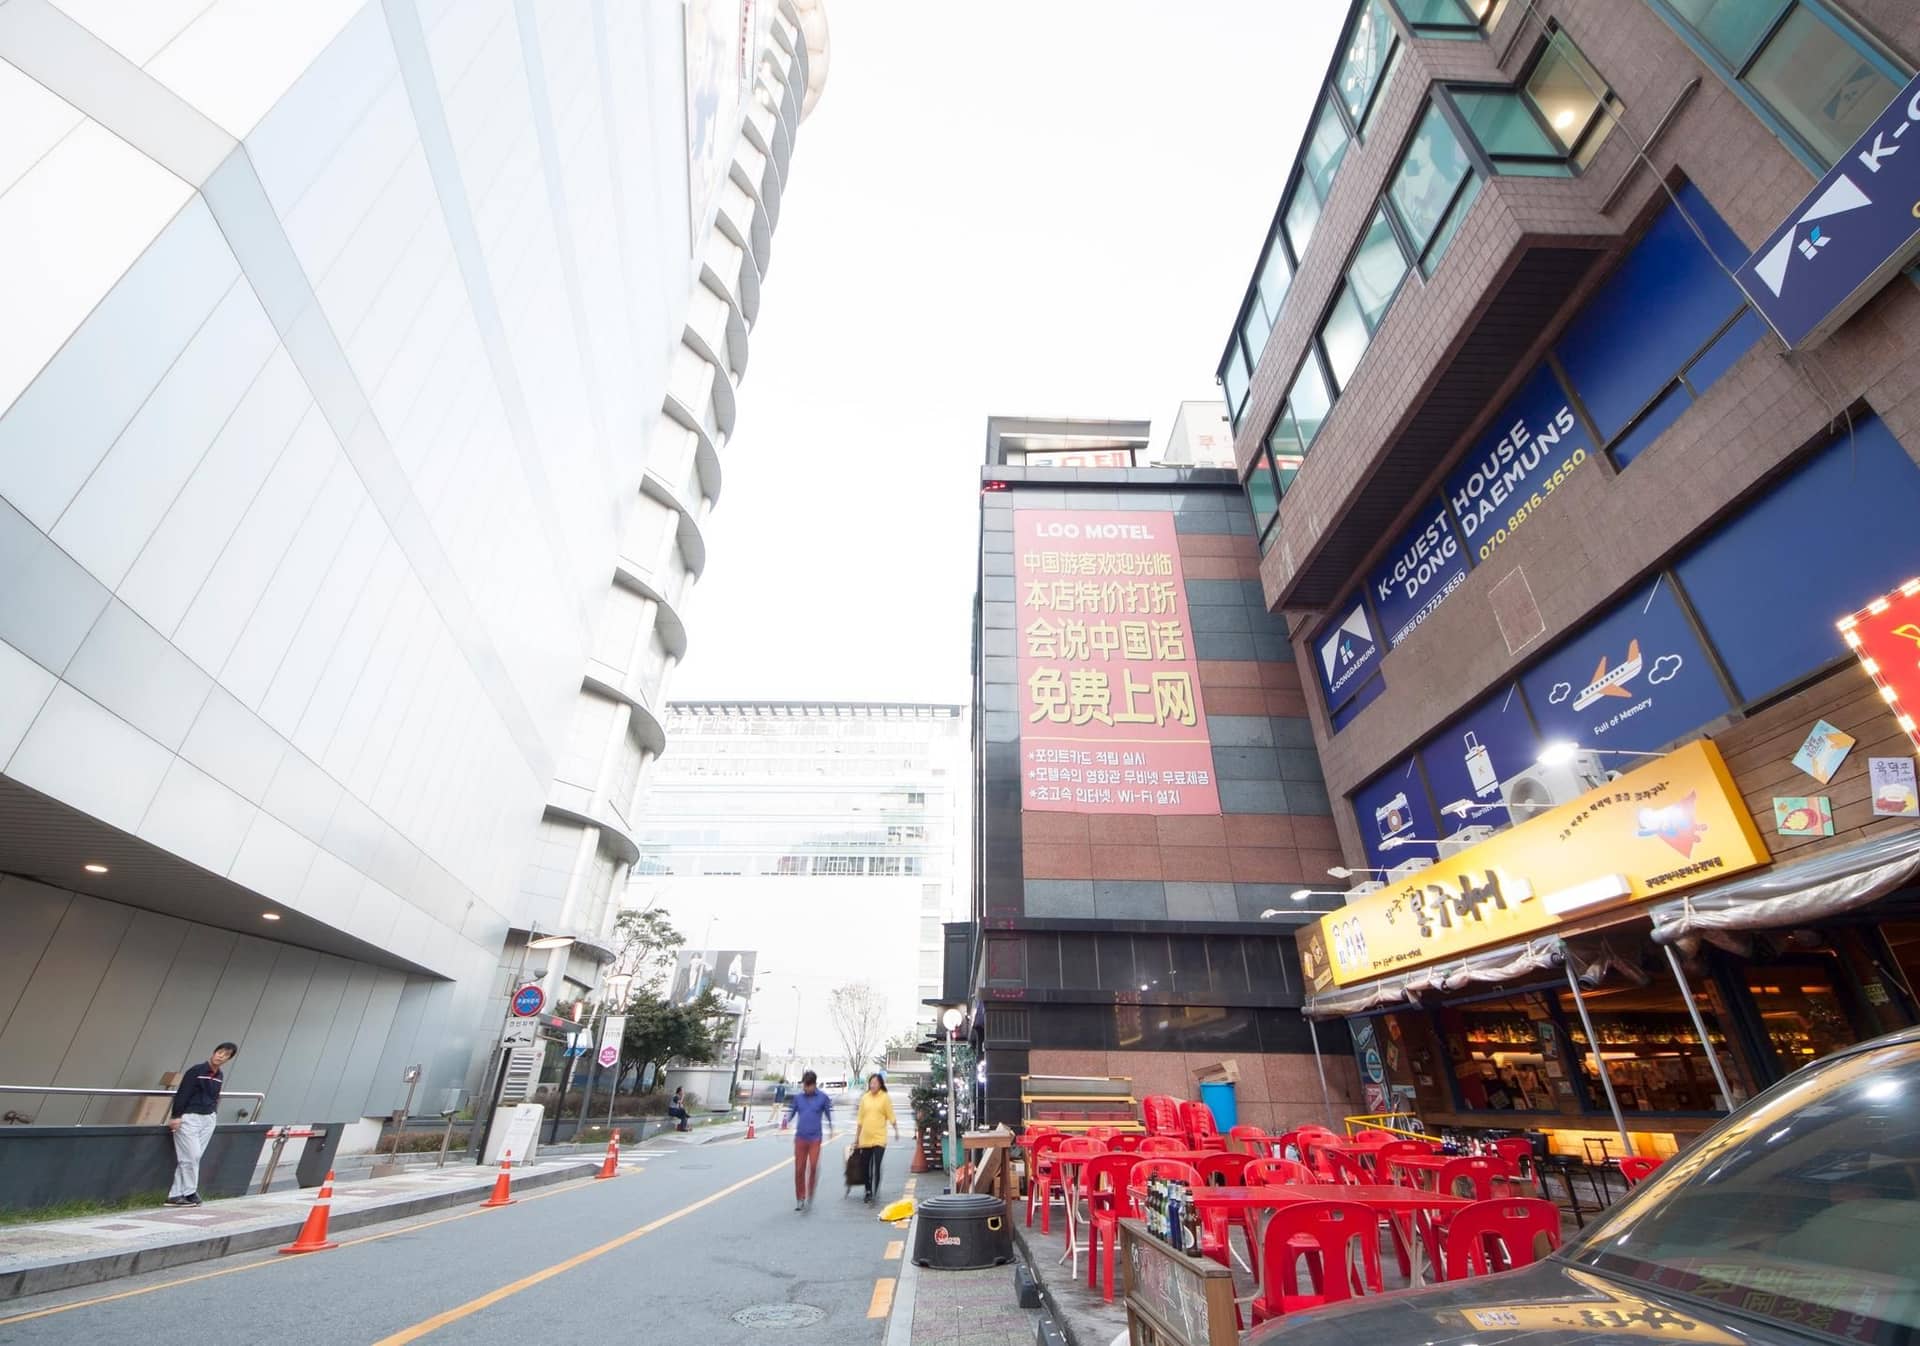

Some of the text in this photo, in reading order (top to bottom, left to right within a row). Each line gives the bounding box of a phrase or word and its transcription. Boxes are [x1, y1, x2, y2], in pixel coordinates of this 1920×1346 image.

[1378, 419, 1531, 602] K-GUEST HOUSE
[1404, 406, 1576, 600] DONG DAEMUN5
[1479, 448, 1587, 561] 070.8816.3650
[1036, 522, 1155, 540] LOO MOTEL
[1023, 551, 1173, 576] 中国游客欢迎光临
[1023, 579, 1178, 614] 本店特价打折
[1415, 572, 1466, 625] 02.722.3650
[1025, 617, 1186, 661] 会说中国话
[1027, 666, 1199, 728] 免费上网
[1594, 697, 1652, 736] Full of Memory
[1086, 770, 1120, 785] 영화관
[1124, 771, 1158, 786] 무비넷
[1162, 770, 1209, 786] 무료제공
[1095, 751, 1119, 766] 적립
[1122, 752, 1146, 766] 실시
[1118, 789, 1153, 804] Wi-Fi
